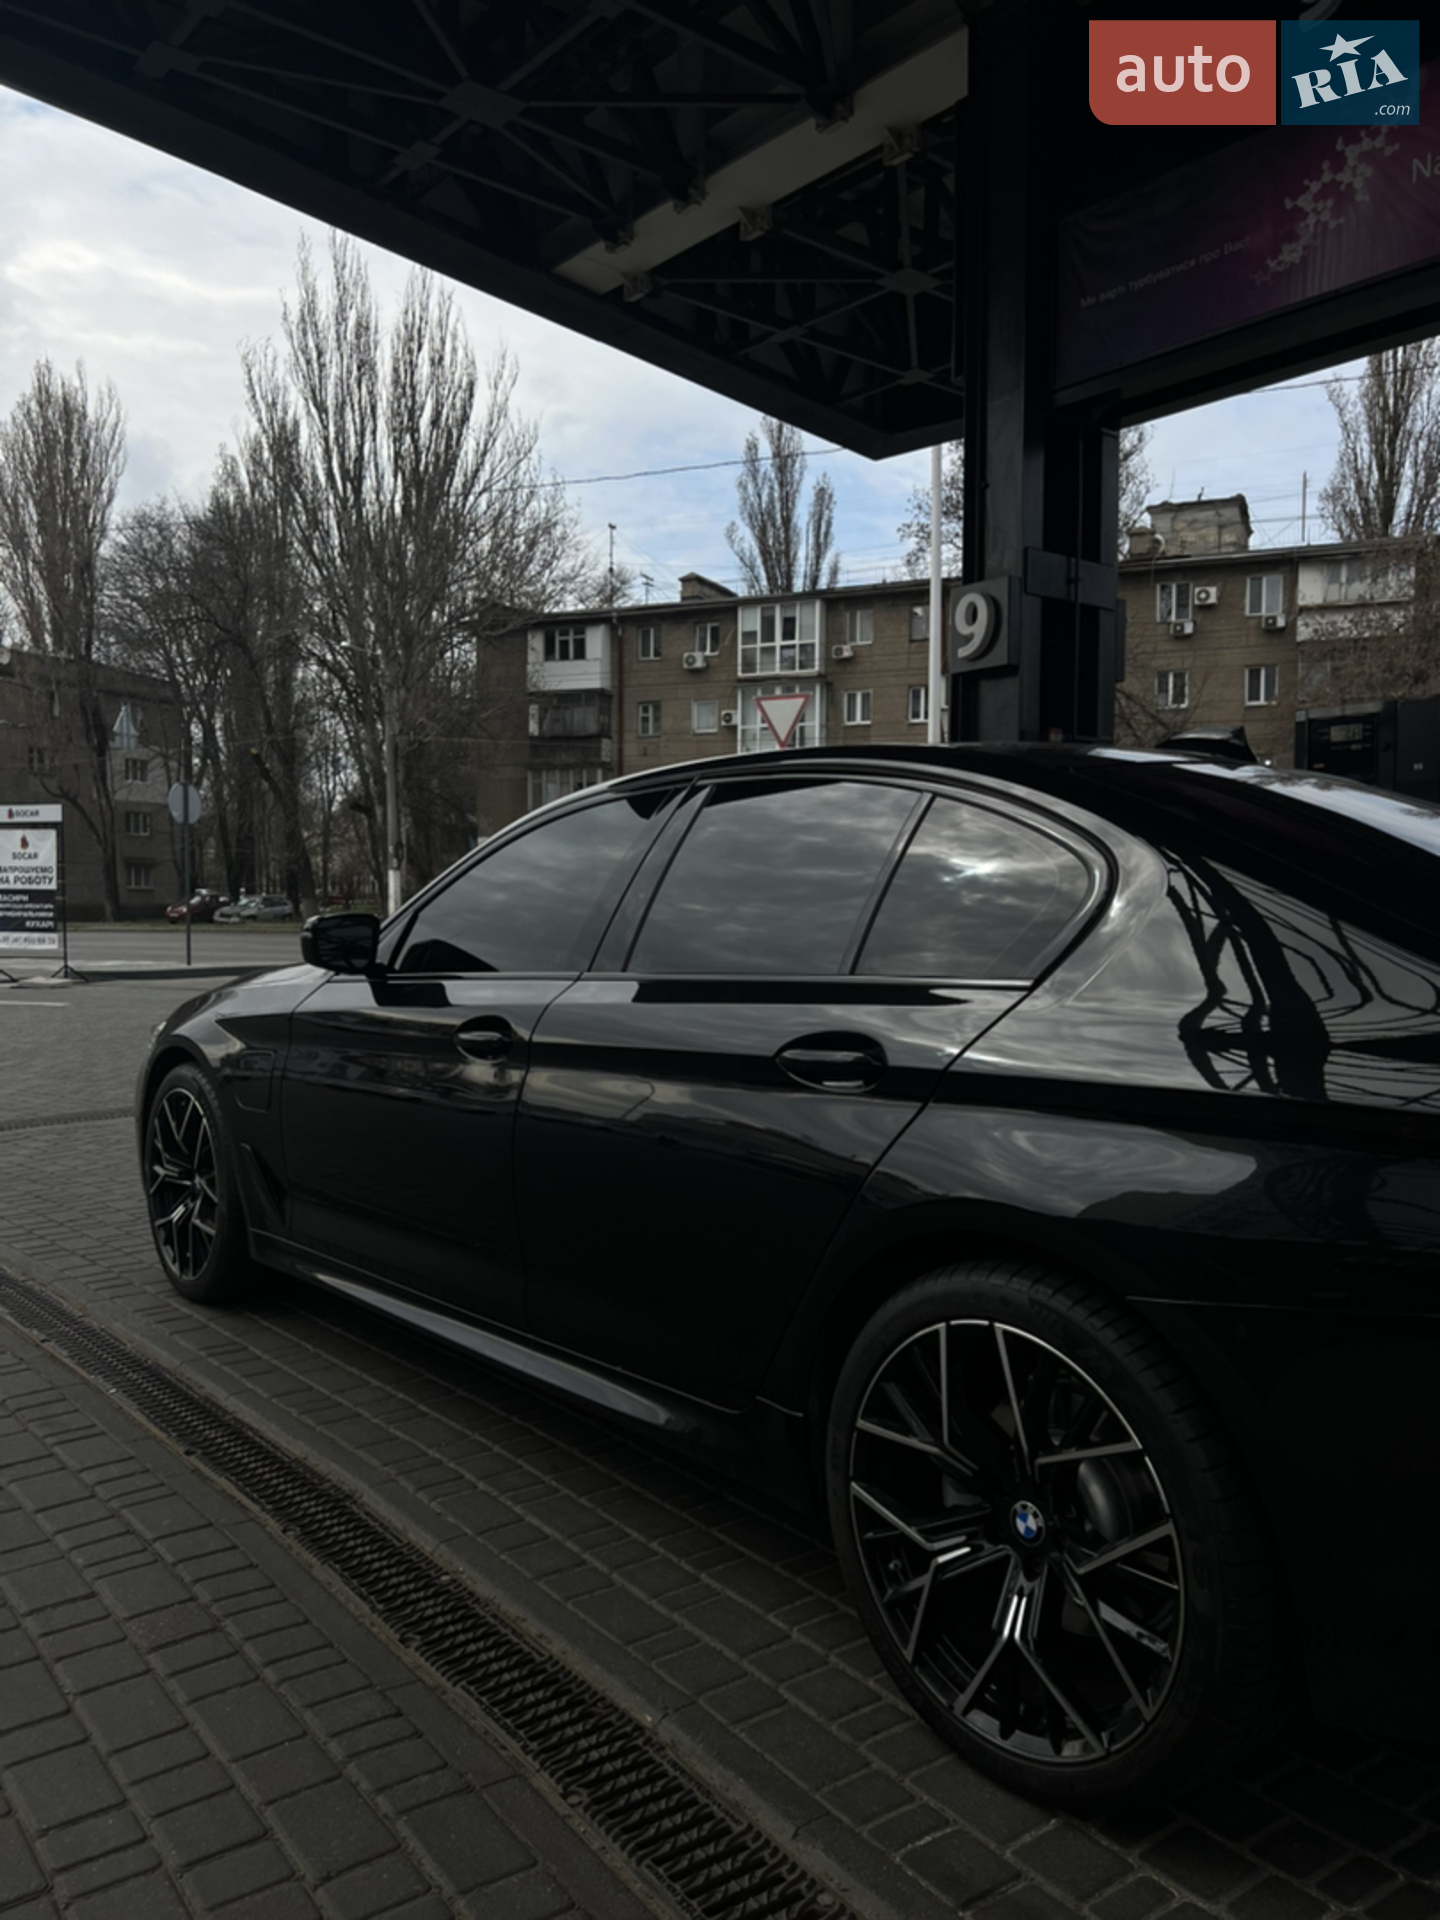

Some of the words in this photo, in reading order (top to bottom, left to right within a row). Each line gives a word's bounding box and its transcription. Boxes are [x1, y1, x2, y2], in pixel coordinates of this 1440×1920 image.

[1199, 248, 1221, 265] про
[954, 592, 989, 660] 9
[15, 809, 40, 818] SOCAR
[12, 851, 39, 860] SOCAR
[14, 875, 54, 885] РОБОТУ
